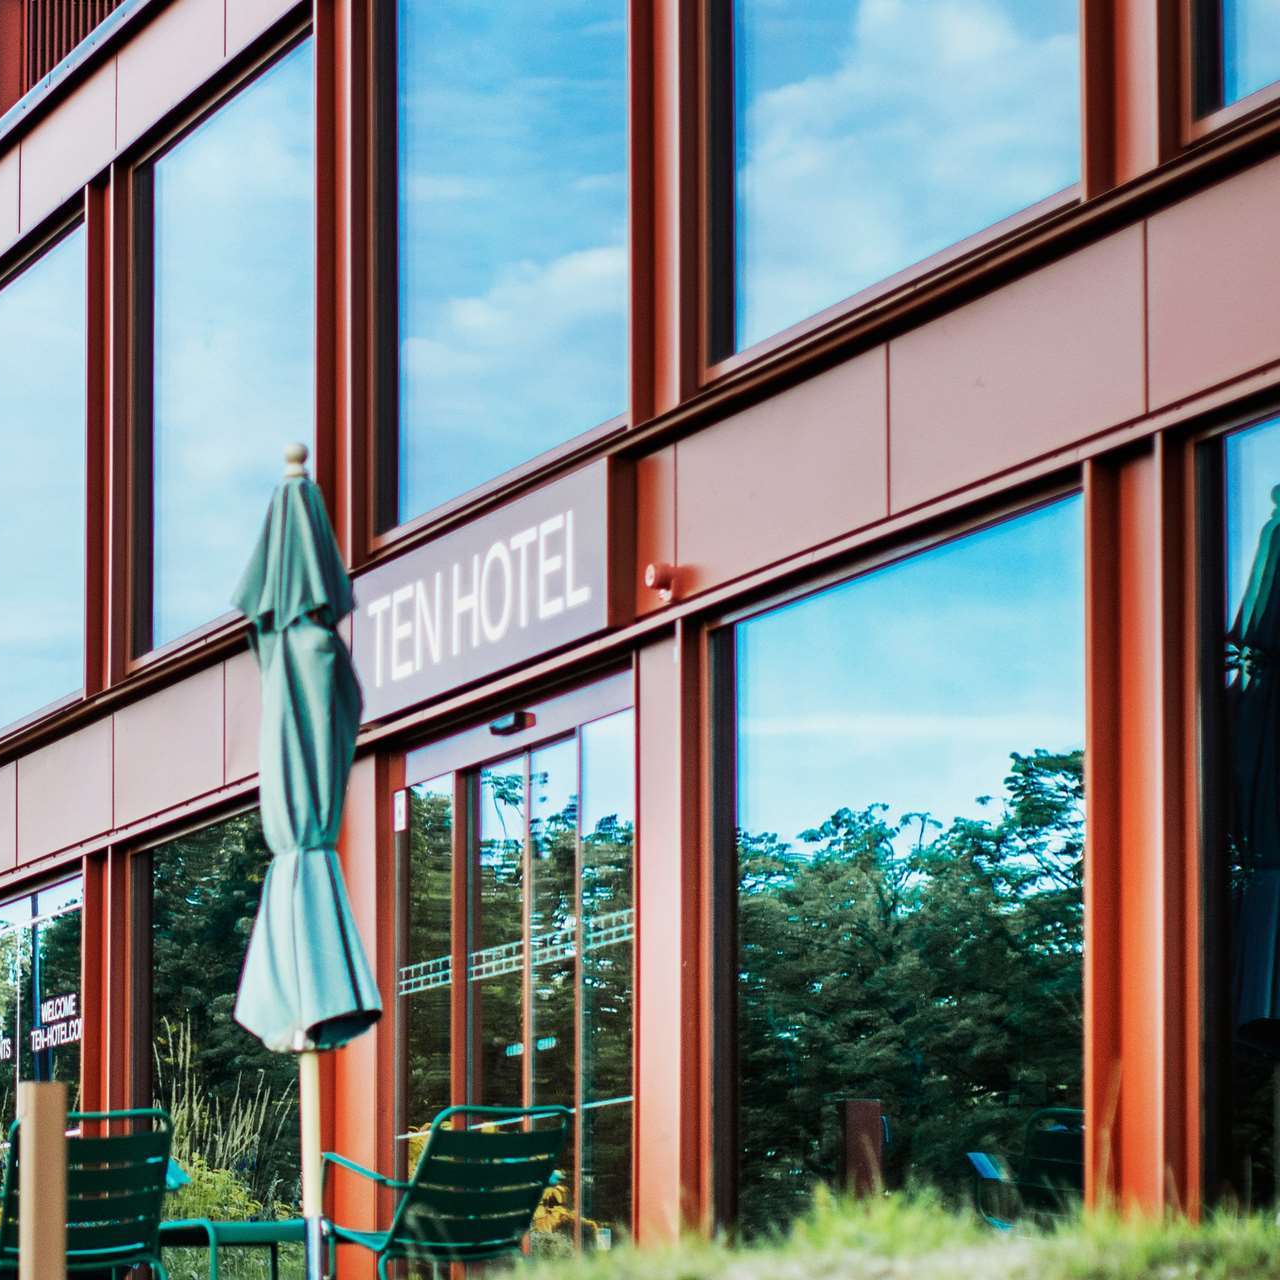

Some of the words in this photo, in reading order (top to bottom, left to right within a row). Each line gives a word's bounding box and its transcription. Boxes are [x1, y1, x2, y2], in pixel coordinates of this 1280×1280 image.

[367, 571, 441, 688] TEN
[452, 509, 591, 657] HOTEL
[41, 993, 76, 1024] WELCOME
